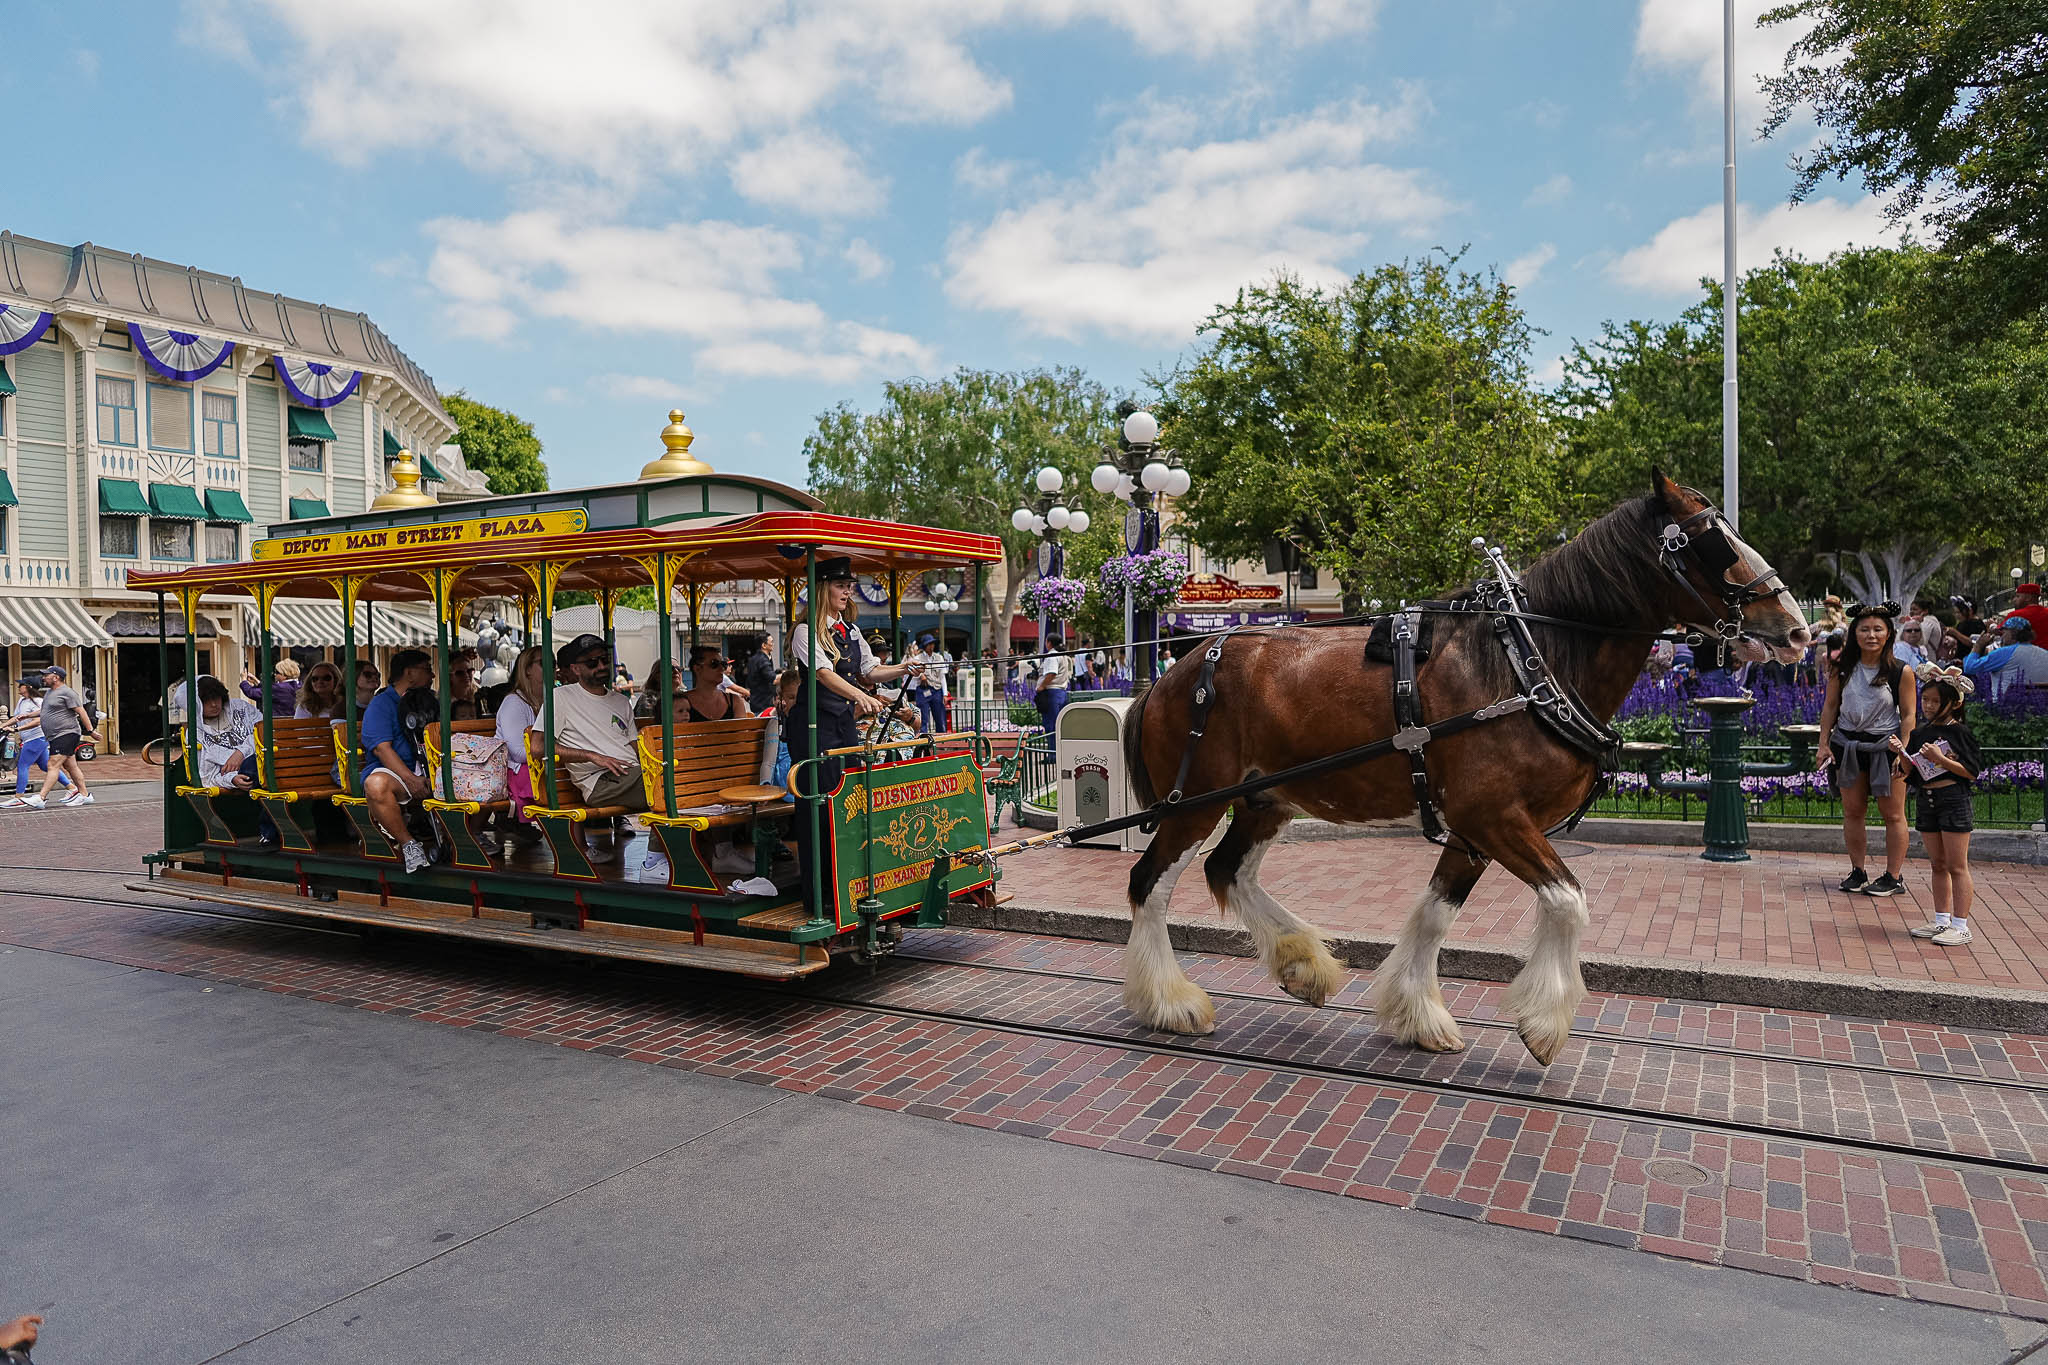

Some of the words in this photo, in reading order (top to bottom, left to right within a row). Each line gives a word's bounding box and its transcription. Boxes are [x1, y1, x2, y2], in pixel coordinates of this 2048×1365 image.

[283, 538, 330, 555] DEPOT
[346, 533, 387, 549] MAIN
[397, 525, 463, 544] STREET
[480, 518, 545, 537] PLAZA
[701, 621, 718, 630] Mad
[723, 621, 751, 630] Hatter
[873, 776, 959, 807] DISNEYLAND
[914, 816, 928, 847] 2
[855, 875, 886, 894] DEOT
[893, 867, 917, 885] MAIN
